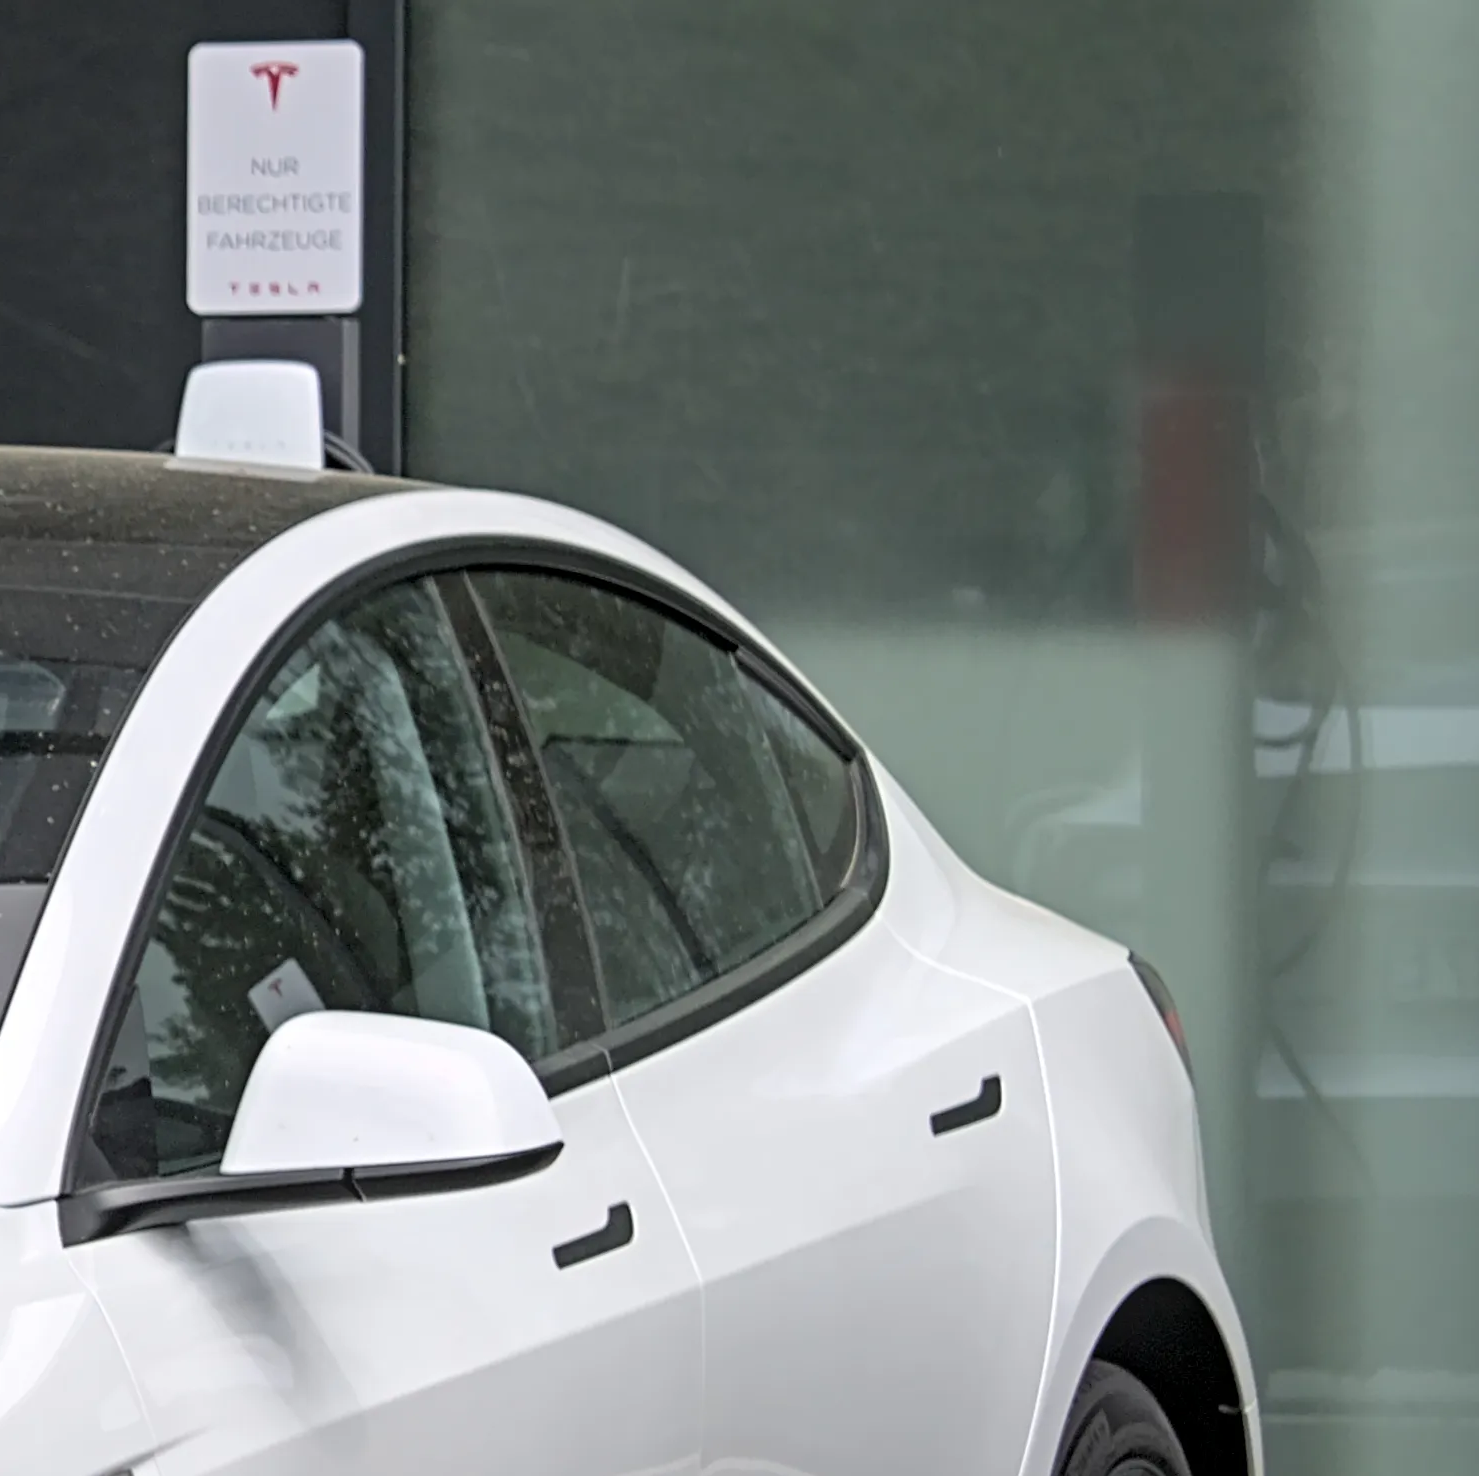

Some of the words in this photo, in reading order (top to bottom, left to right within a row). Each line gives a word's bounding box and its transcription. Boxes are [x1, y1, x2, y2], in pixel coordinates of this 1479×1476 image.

[250, 156, 300, 177] NUR
[197, 192, 352, 215] BERECHTIGTE
[206, 230, 343, 251] FAHRZEUGE
